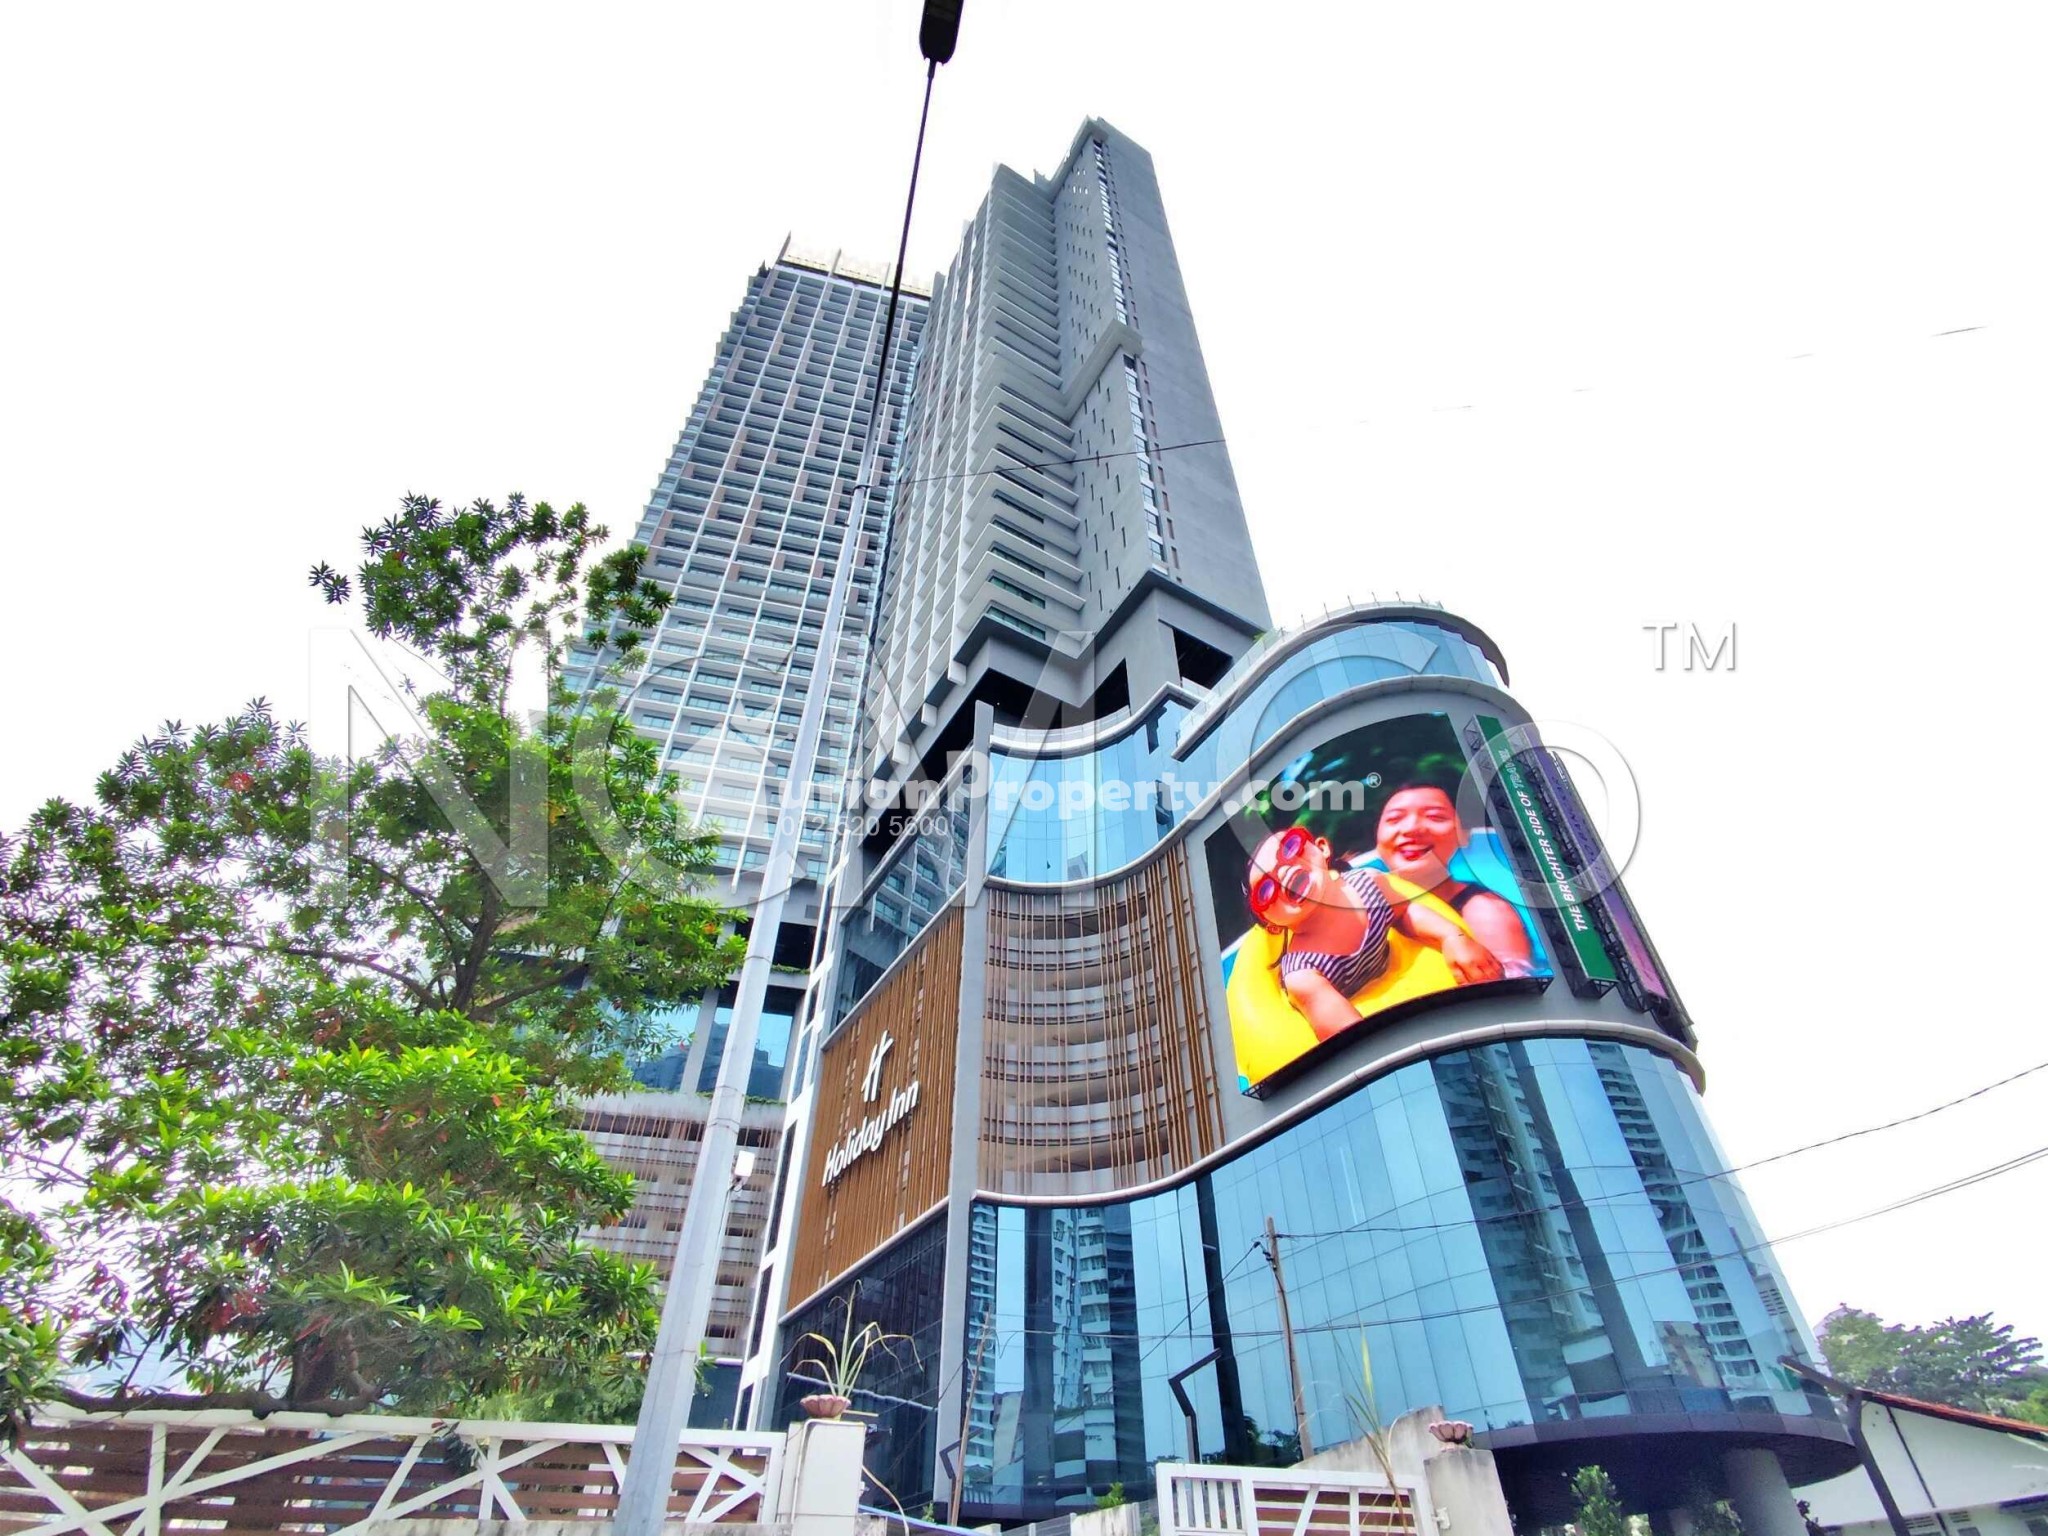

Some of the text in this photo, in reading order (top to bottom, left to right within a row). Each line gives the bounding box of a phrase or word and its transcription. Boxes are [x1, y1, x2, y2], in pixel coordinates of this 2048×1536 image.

[1517, 791, 1532, 808] OF
[1525, 809, 1545, 837] SIDE
[1538, 839, 1576, 902] BRIGHTER
[1568, 903, 1588, 932] THE
[822, 1080, 920, 1187] Holiday Inn
